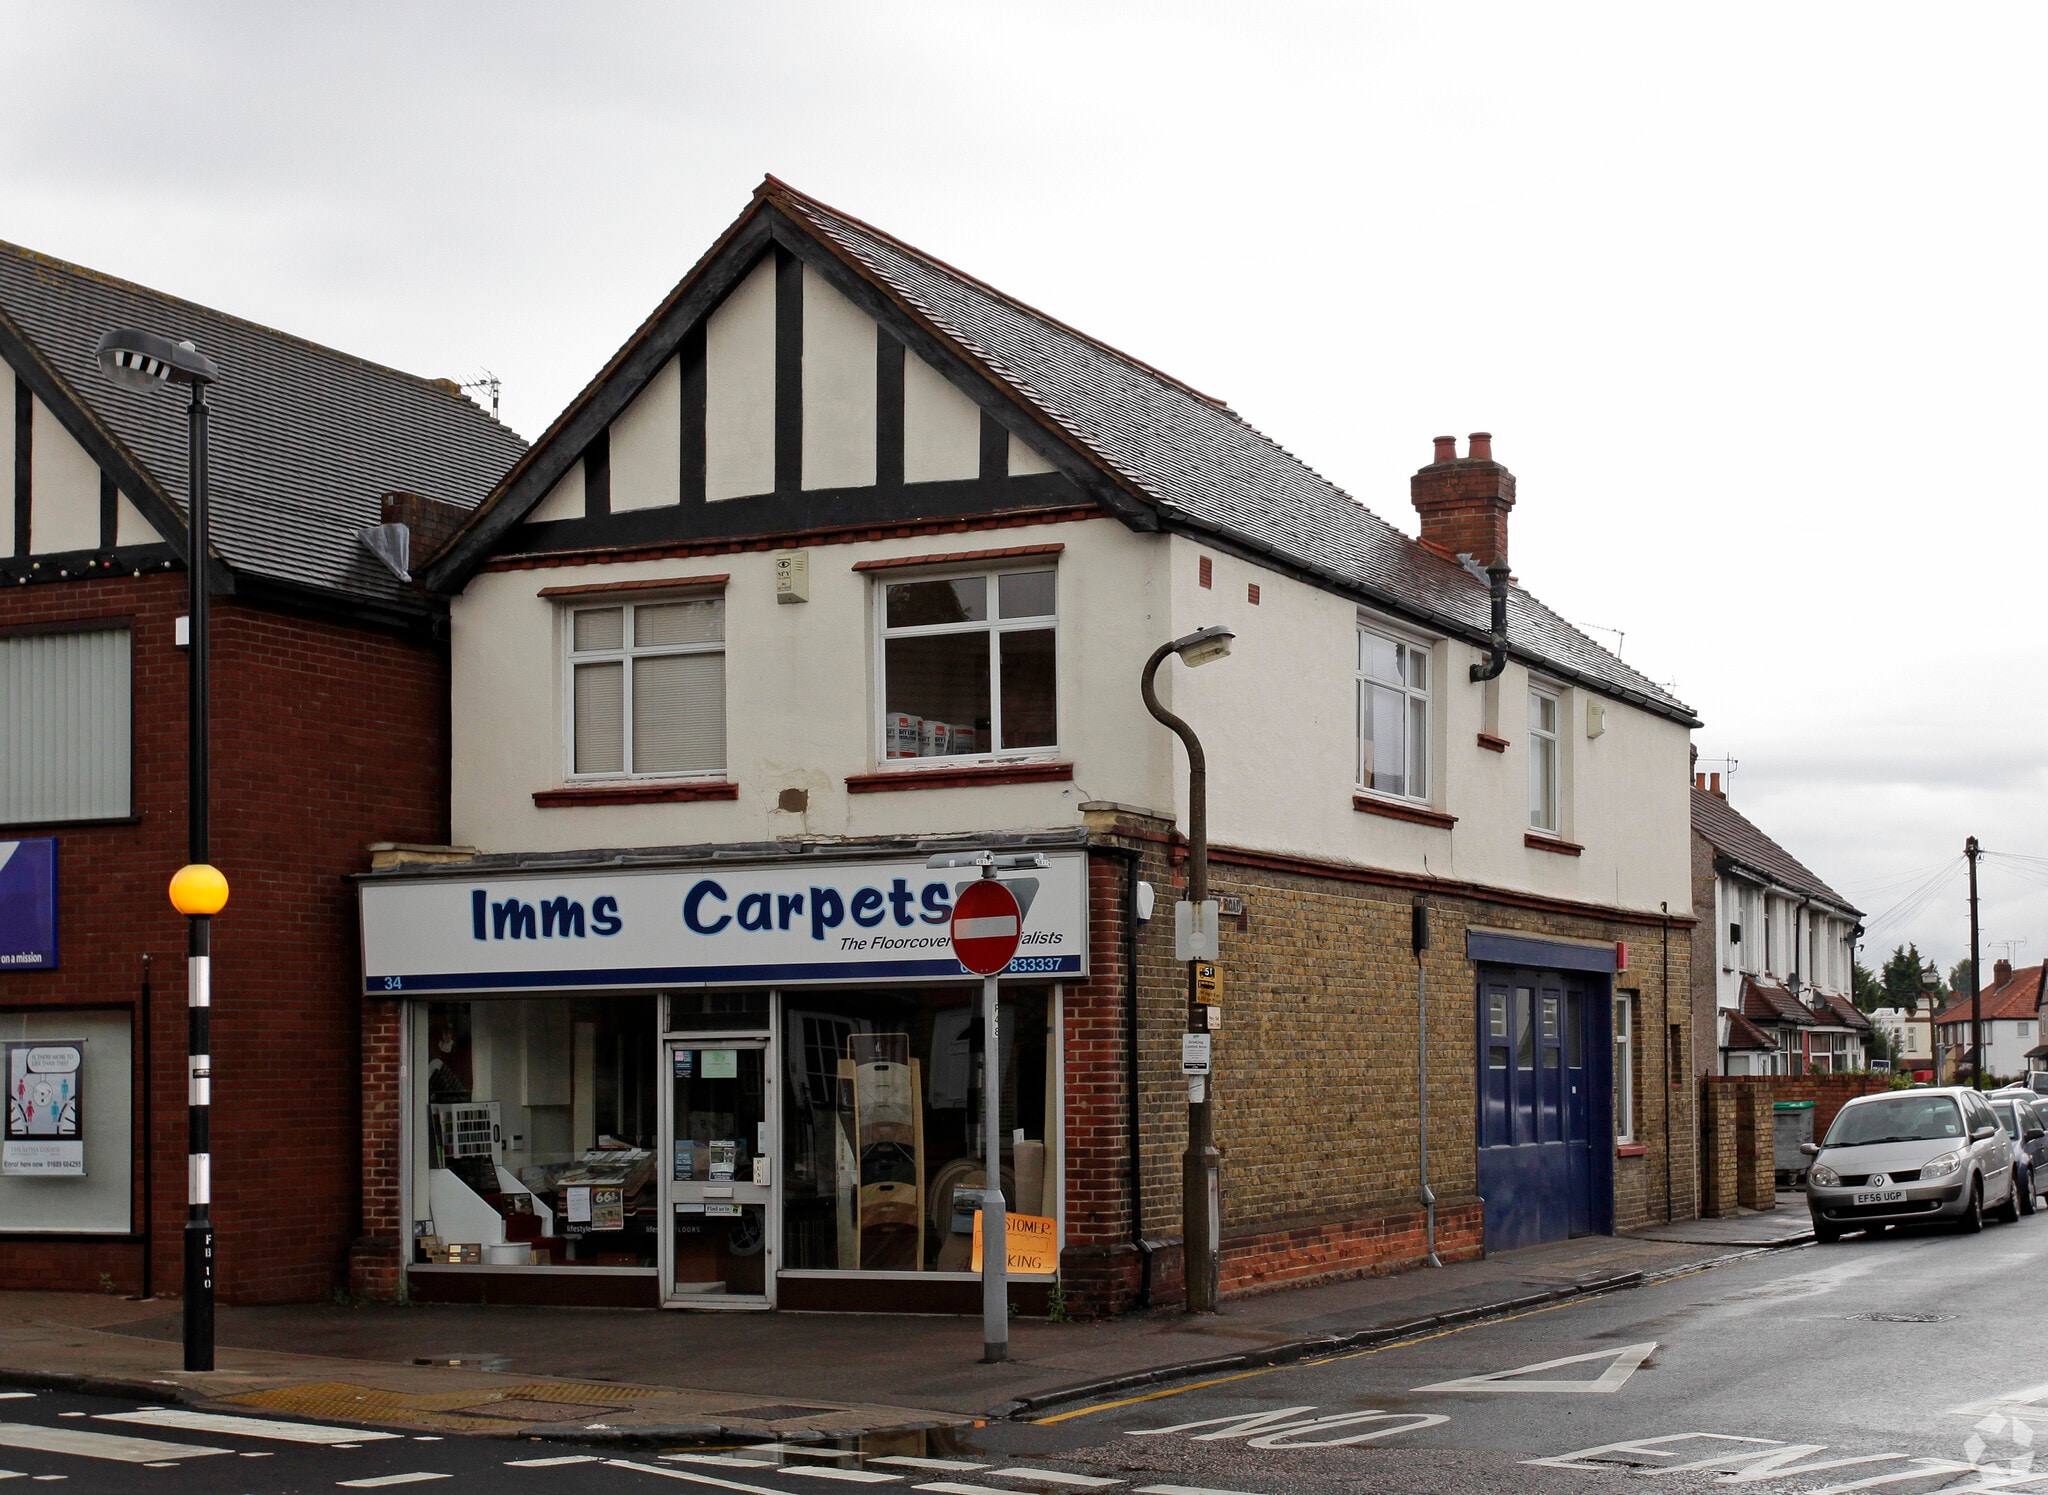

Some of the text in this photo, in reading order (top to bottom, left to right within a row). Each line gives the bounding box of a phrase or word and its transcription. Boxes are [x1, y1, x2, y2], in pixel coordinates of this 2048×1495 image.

[471, 877, 953, 942] Imms Carpets
[1223, 898, 1241, 913] ROAD
[840, 931, 1063, 951] The Floorcover ialists
[1, 951, 42, 964] on a mission
[1009, 957, 1063, 973] 833337
[384, 976, 402, 990] 34
[1858, 1191, 1902, 1203] EF56 UGP
[567, 1224, 592, 1233] lifestyle
[646, 1225, 658, 1233] lifes
[1005, 1217, 1052, 1235] STOMER
[1008, 1254, 1042, 1269] KING
[1124, 1406, 1450, 1449] NO
[1516, 1432, 2048, 1495] ENT
